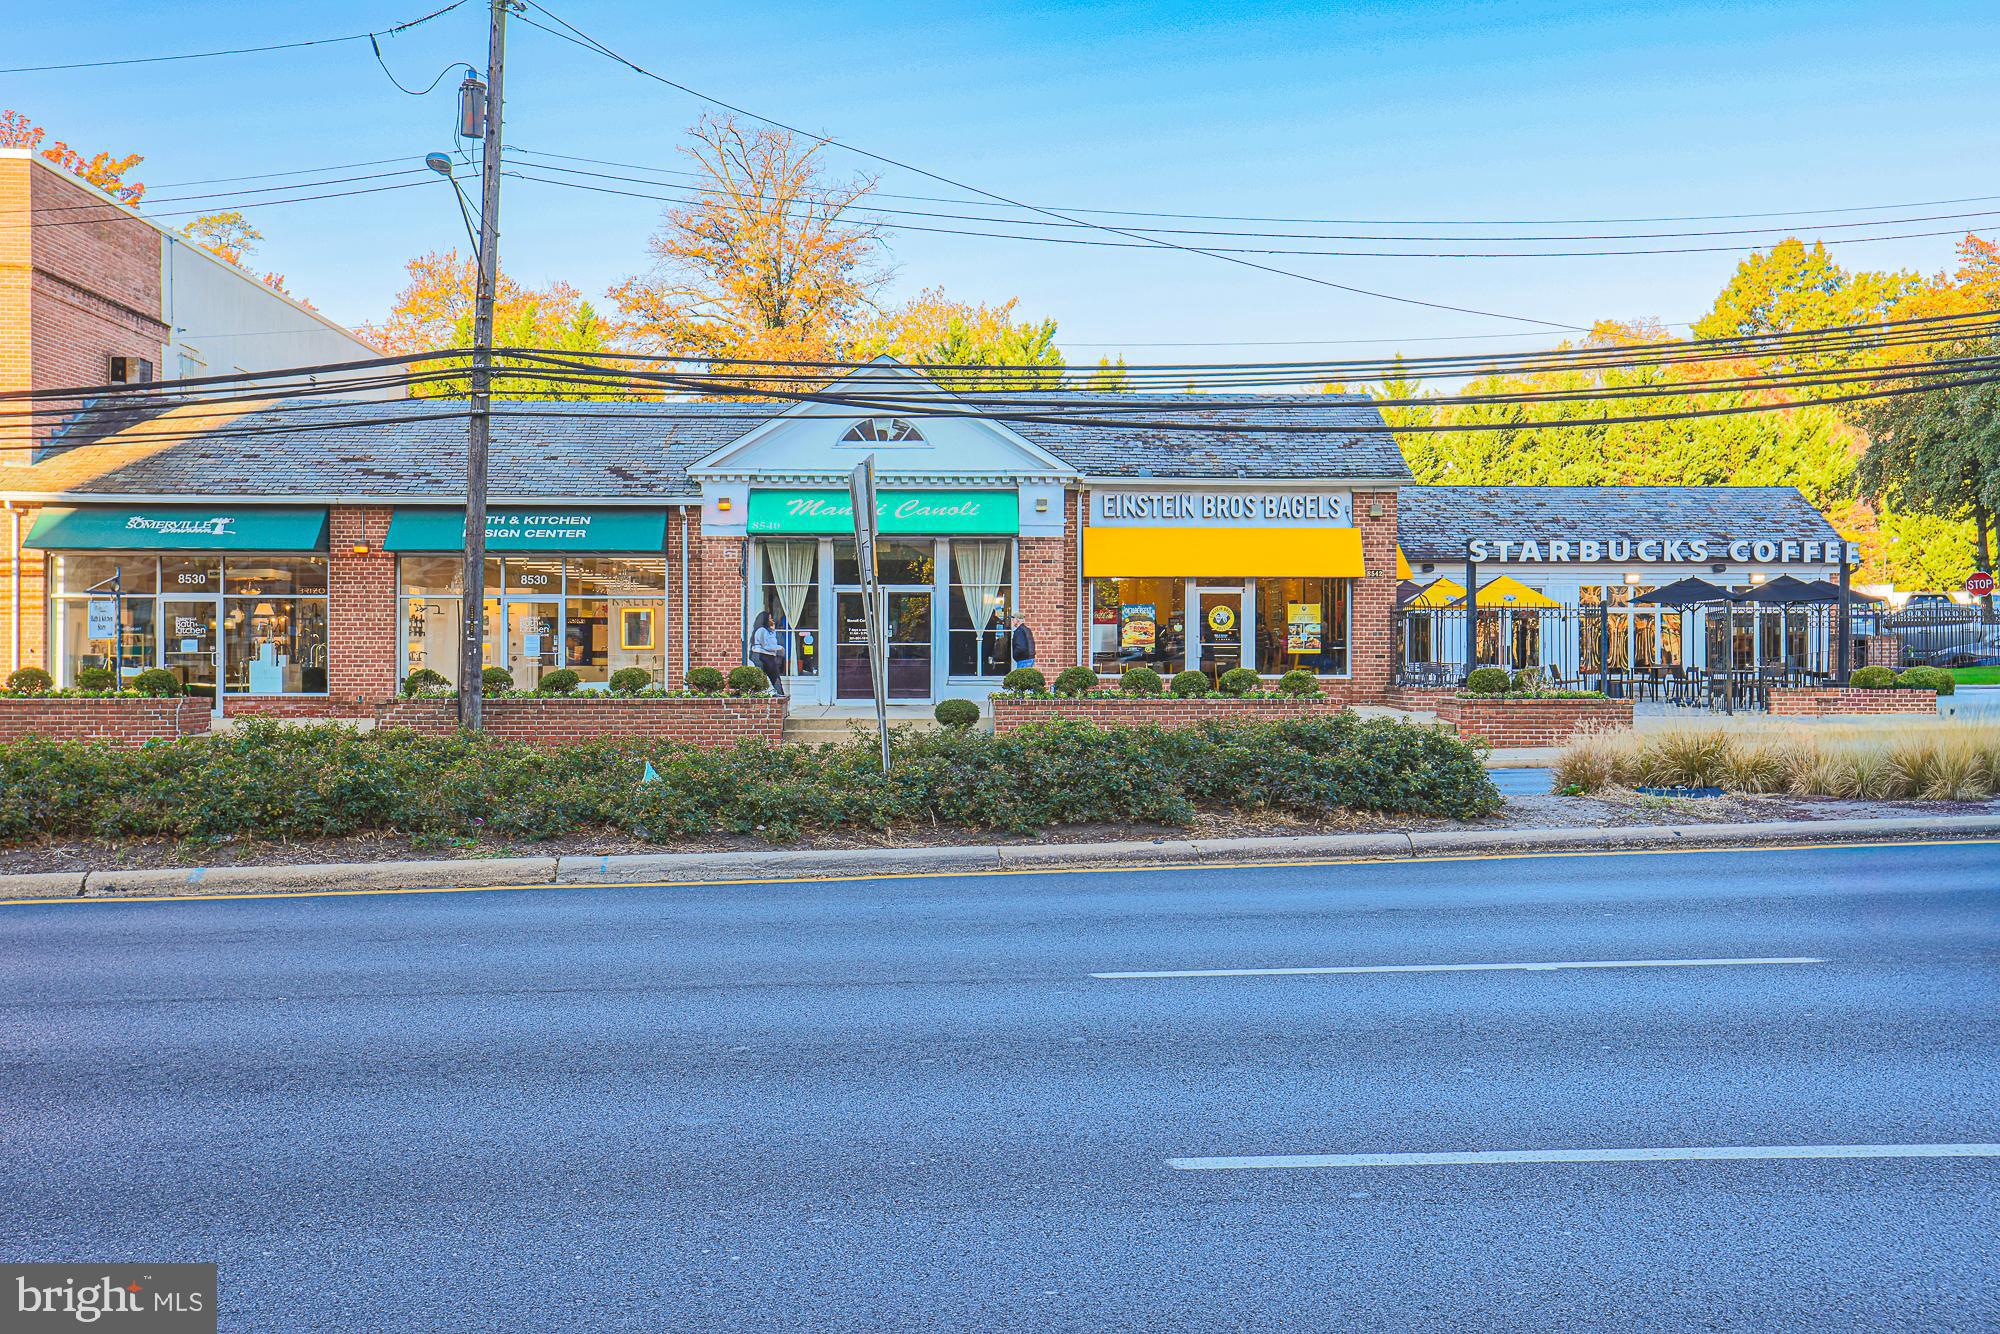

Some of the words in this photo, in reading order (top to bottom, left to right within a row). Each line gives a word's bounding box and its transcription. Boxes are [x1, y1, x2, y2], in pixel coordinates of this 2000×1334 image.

[895, 499, 980, 519] Canoli
[1103, 493, 1195, 518] EINSTEIN
[1263, 494, 1343, 519] BAGELS
[125, 519, 212, 529] SOMERVILLE
[509, 516, 520, 525] &
[523, 515, 592, 525] KITCHEN
[524, 529, 587, 538] CENTER
[1469, 540, 1709, 563] STARBUCKS
[1729, 541, 1861, 564] COFFEE
[178, 573, 206, 584] 8530
[520, 574, 548, 585] 8530
[1968, 579, 1992, 590] STOP
